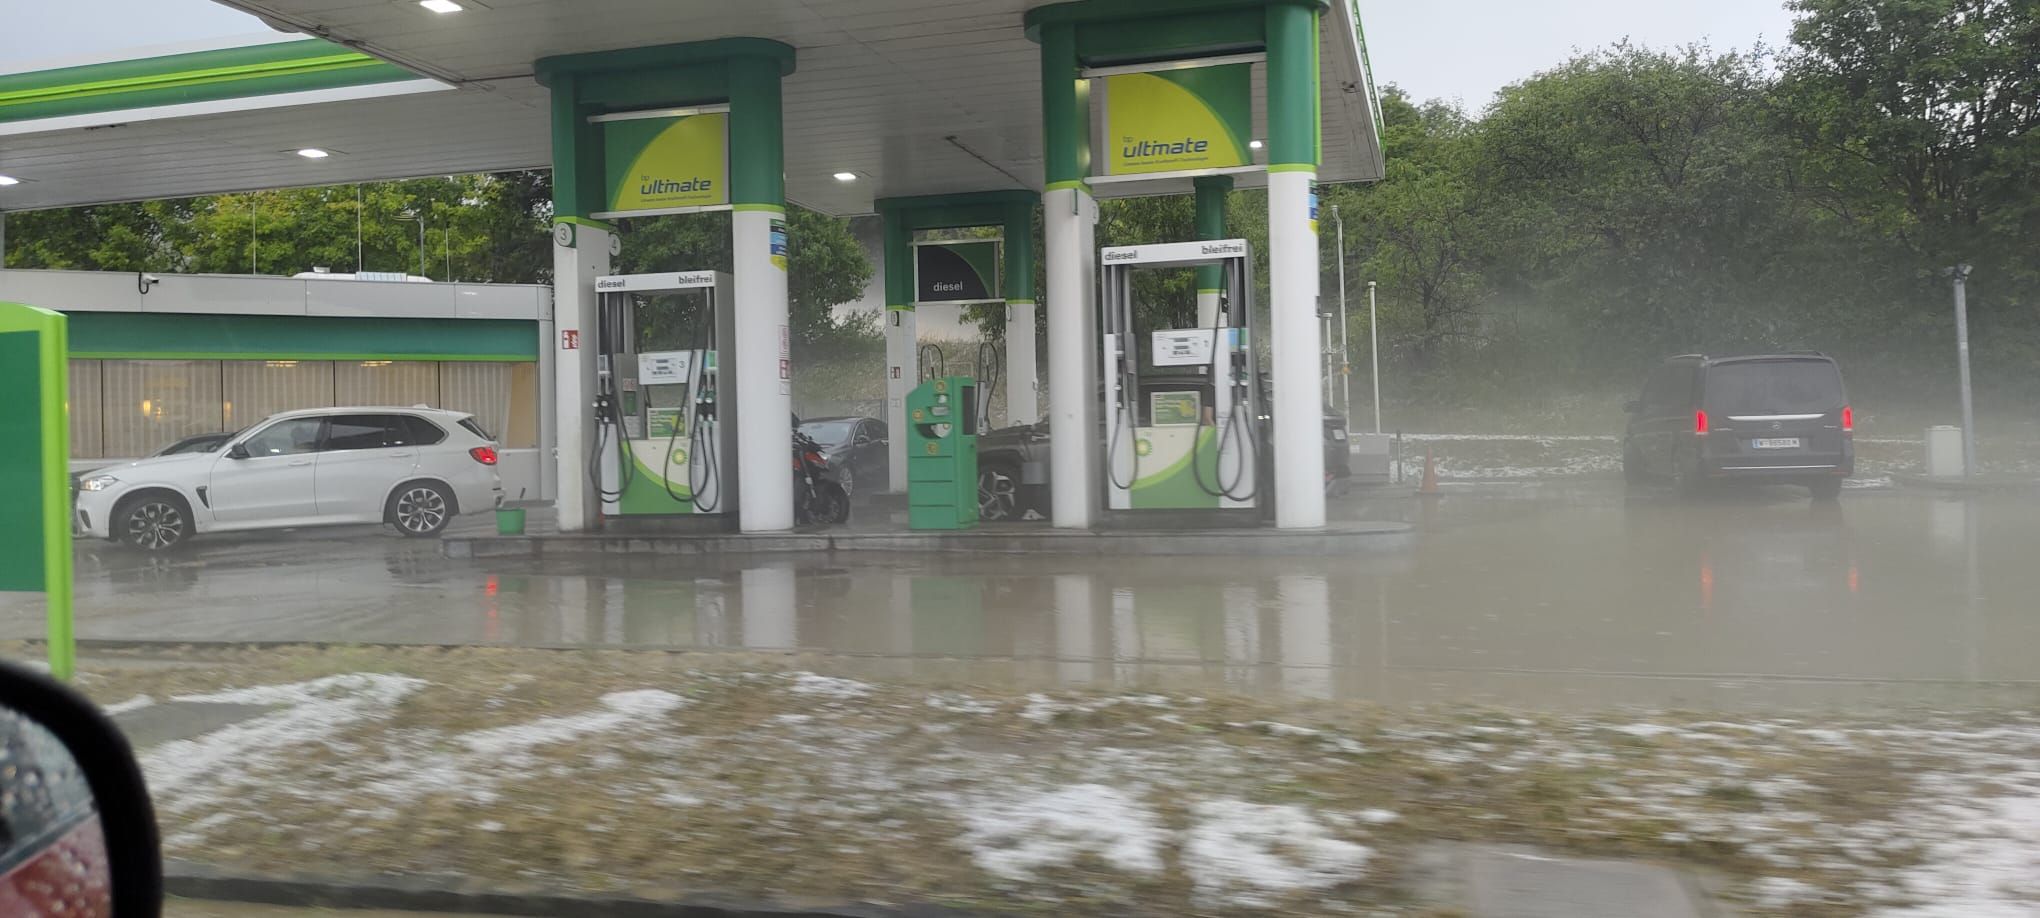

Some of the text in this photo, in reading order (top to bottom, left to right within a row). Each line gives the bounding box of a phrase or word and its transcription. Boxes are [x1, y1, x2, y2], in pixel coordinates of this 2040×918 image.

[1123, 137, 1208, 158] ultimate
[640, 176, 711, 195] ultimate
[560, 227, 568, 241] 3
[1104, 244, 1243, 260] diesel bleifrei
[597, 274, 713, 289] diesel bleifrei
[933, 280, 963, 291] diesel
[679, 360, 685, 369] 3
